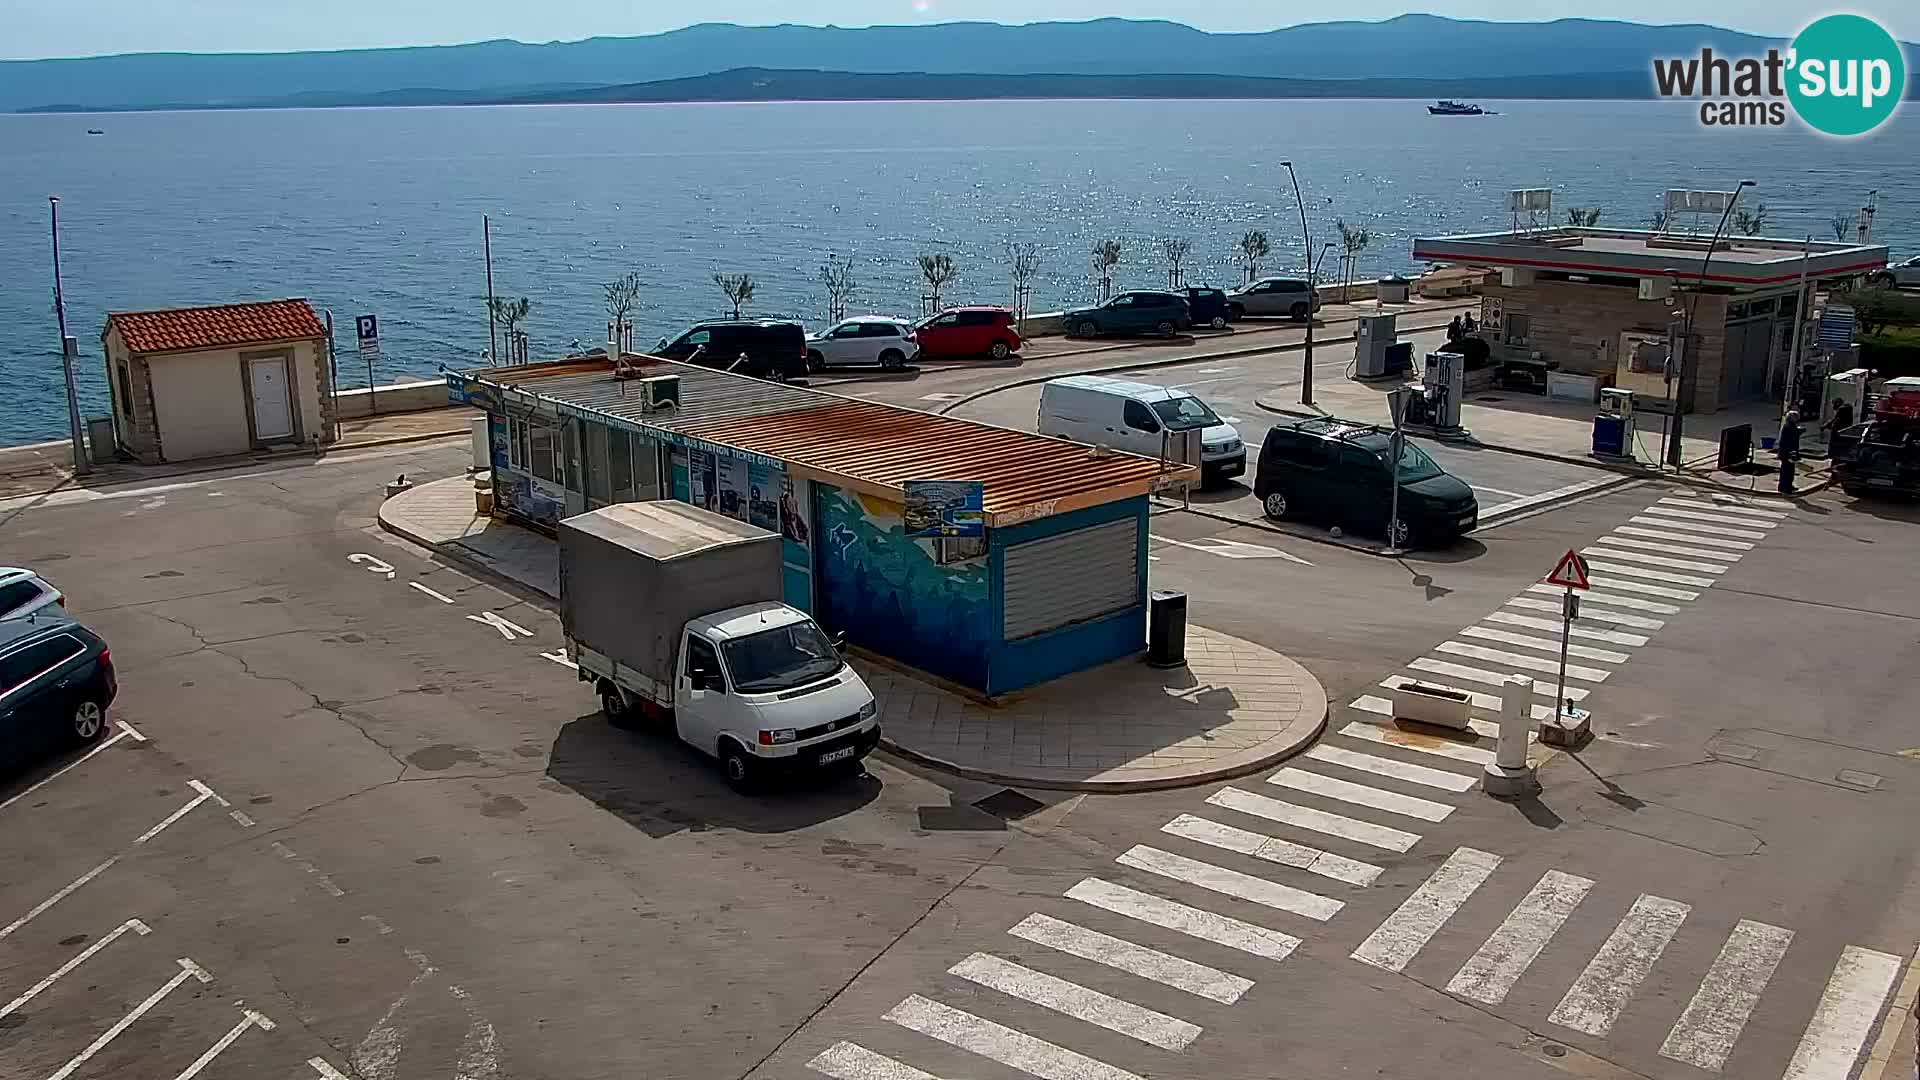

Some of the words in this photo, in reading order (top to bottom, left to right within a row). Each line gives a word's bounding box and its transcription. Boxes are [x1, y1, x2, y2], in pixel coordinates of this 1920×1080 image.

[361, 318, 373, 336] P
[683, 439, 698, 449] BUS
[699, 442, 730, 457] STATION
[731, 449, 756, 464] TICKET
[757, 456, 784, 470] OFFICE
